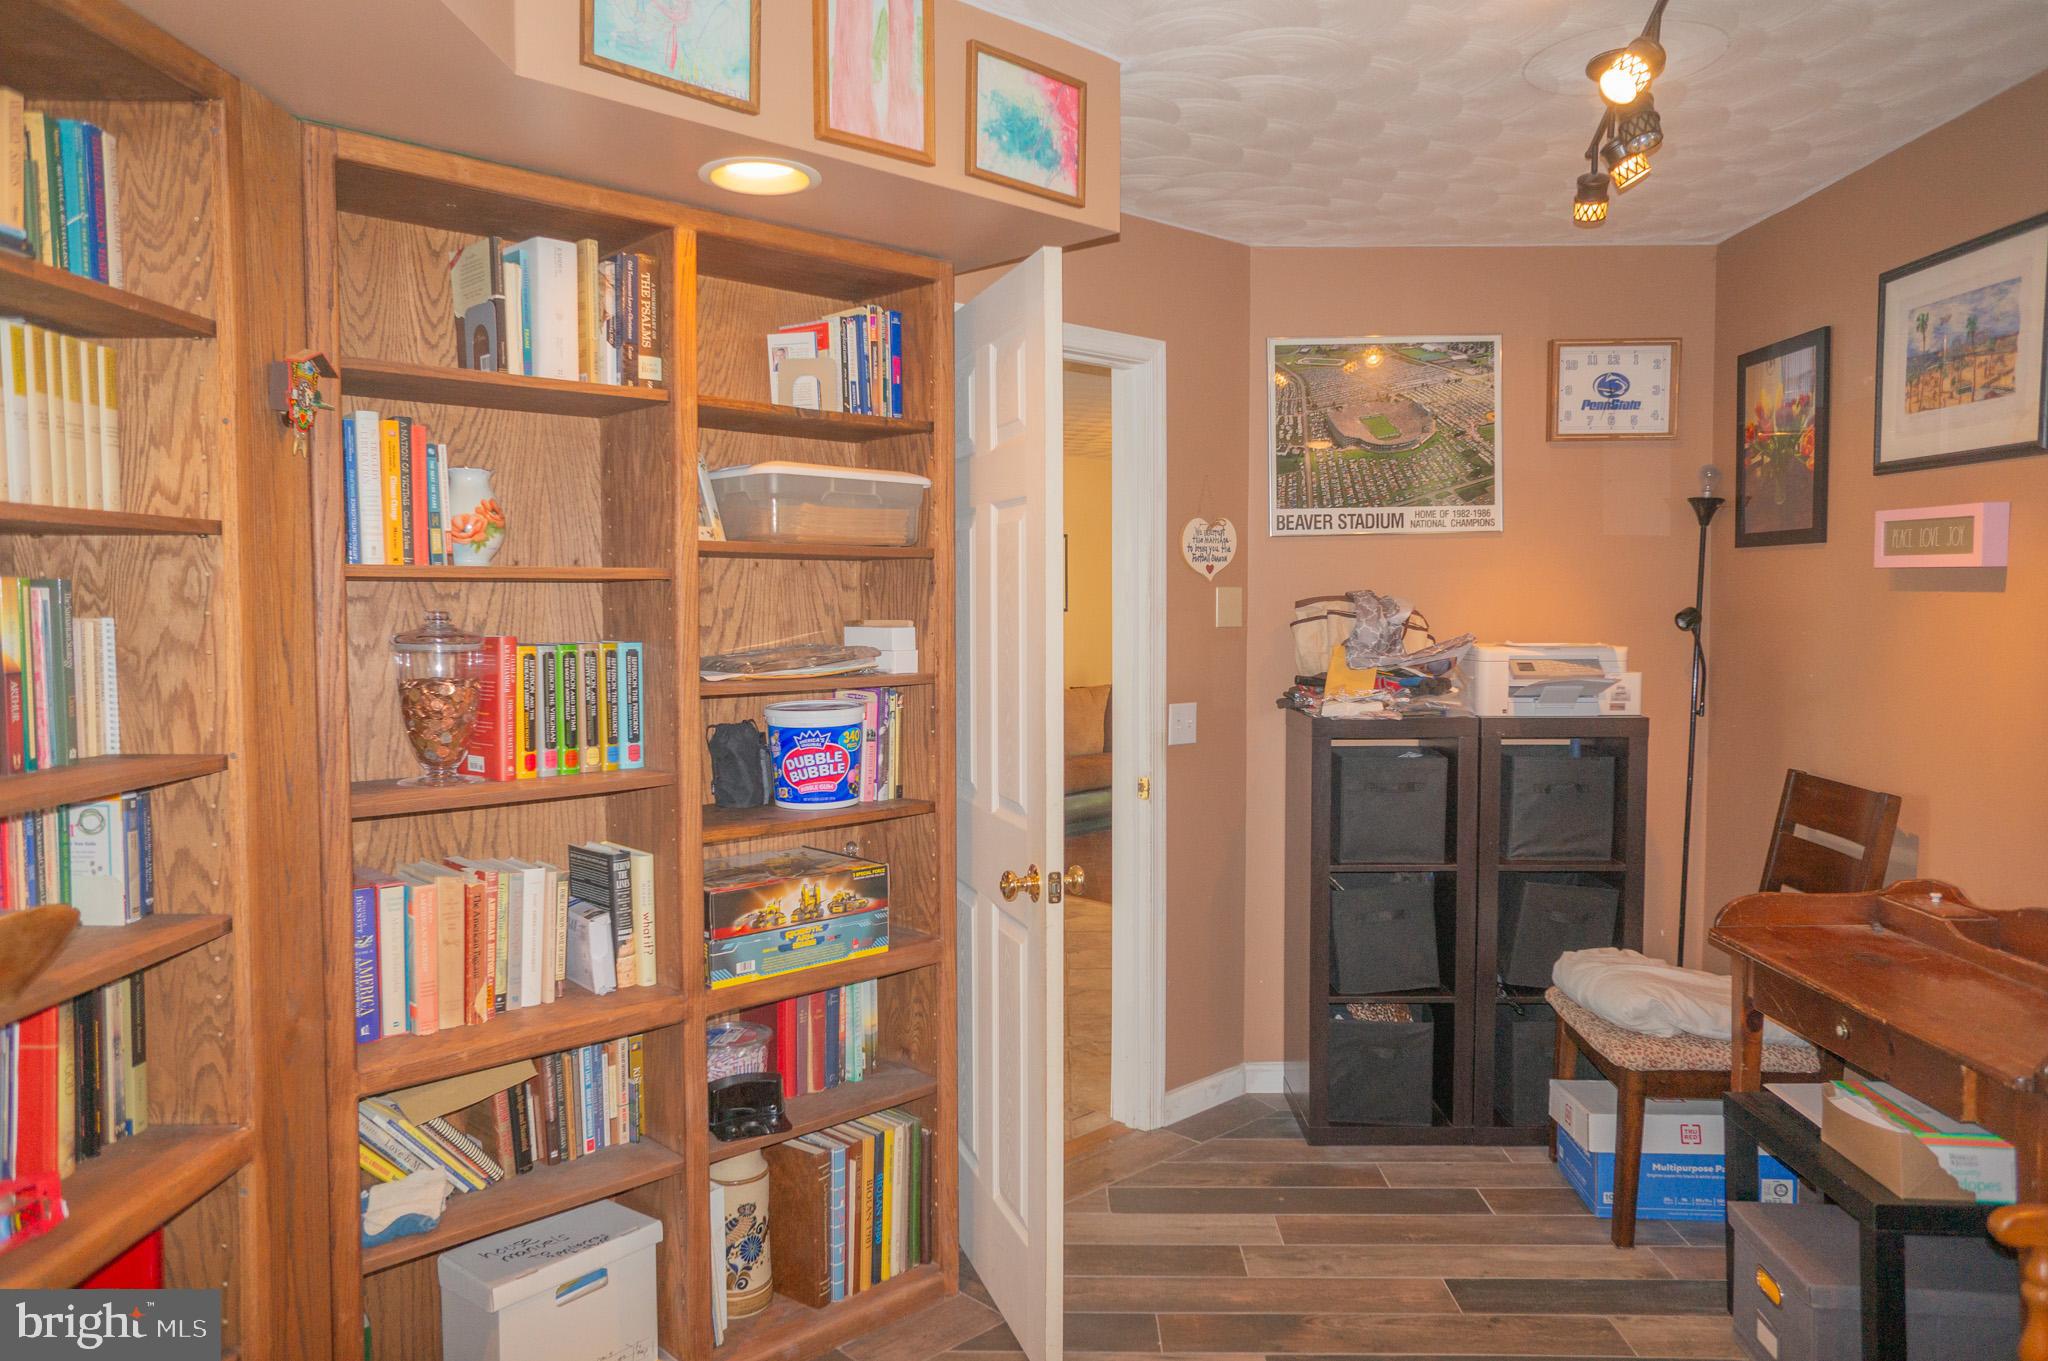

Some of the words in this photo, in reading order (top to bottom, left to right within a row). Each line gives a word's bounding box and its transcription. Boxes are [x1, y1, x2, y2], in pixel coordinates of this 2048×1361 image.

[640, 272, 651, 298] THE
[640, 300, 651, 349] PSALMS
[400, 429, 409, 461] NATION
[402, 474, 410, 506] VICTIMS
[1276, 513, 1334, 531] BEAVER
[1338, 512, 1405, 530] STADIUM
[1410, 519, 1447, 528] NATIONAL
[1450, 518, 1496, 528] CHAMPIONS
[1414, 510, 1436, 519] HOME
[1439, 510, 1450, 518] OF
[1452, 508, 1491, 518] 1982-1986
[1892, 529, 1912, 548] PEACE
[1920, 527, 1940, 547] LOVE
[1947, 525, 1966, 547] JOY
[10, 681, 19, 722] ARTHUR
[843, 730, 860, 744] 340
[785, 751, 843, 770] DUBBLE
[789, 763, 846, 783] BUBBLE
[616, 880, 630, 889] LINES
[618, 871, 628, 880] THE
[473, 894, 481, 910] The
[356, 895, 364, 933] BENNETT
[487, 897, 496, 941] AMERICAN
[643, 912, 653, 939] what
[473, 911, 481, 950] American
[487, 943, 495, 977] HISTORY
[643, 941, 654, 956] if?
[360, 957, 375, 1018] AMERICA
[1652, 1162, 1713, 1174] Multipurpose
